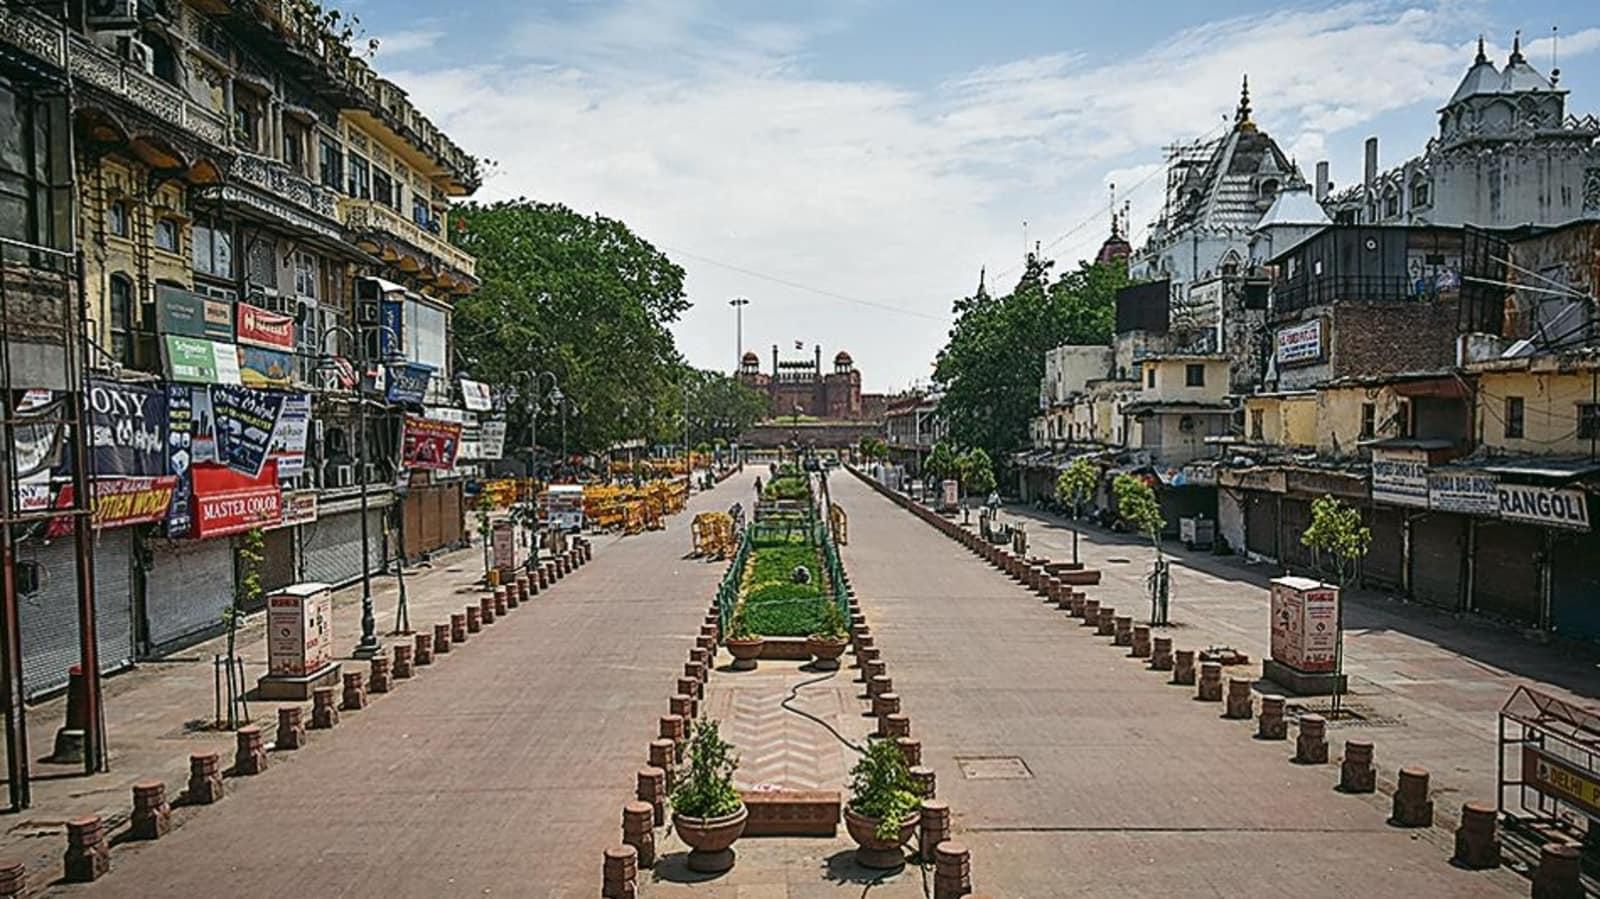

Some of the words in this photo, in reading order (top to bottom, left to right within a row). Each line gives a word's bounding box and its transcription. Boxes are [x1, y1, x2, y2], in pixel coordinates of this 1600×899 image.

[203, 501, 247, 521] MASTER
[247, 495, 278, 514] COLOR
[1499, 489, 1587, 522] RANGOLI
[1550, 766, 1582, 796] DELHI
